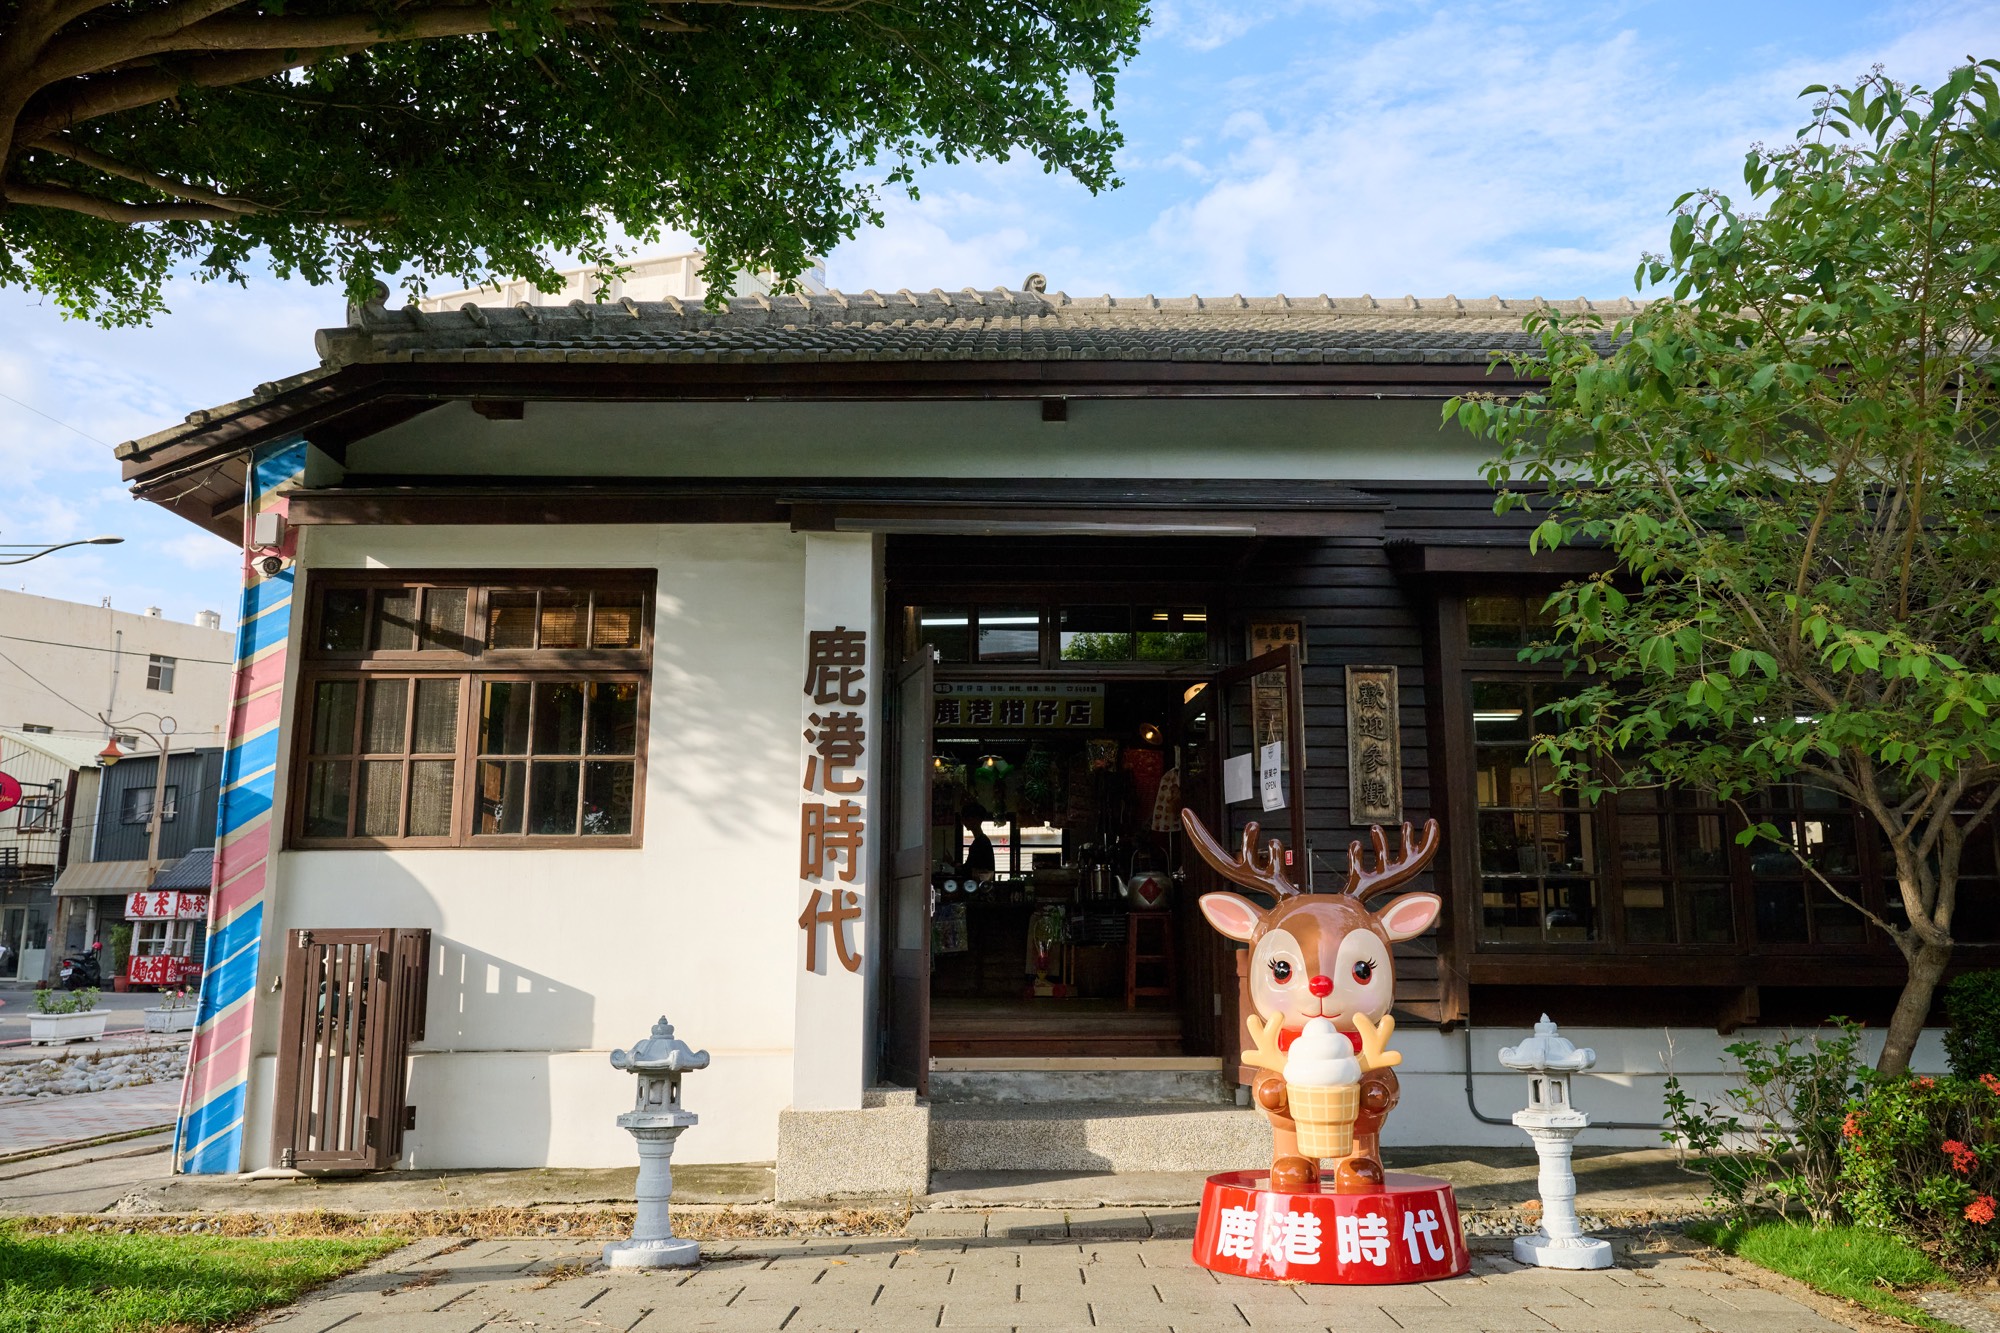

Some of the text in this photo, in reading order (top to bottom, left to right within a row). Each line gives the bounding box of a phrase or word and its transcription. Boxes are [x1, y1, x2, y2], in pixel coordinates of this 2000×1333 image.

[934, 699, 1092, 725] 鹿港柑仔店
[1357, 682, 1389, 808] 歡迎參觀
[799, 626, 866, 972] 鹿港時代
[1264, 781, 1277, 791] OPEN
[131, 891, 171, 917] 麵茶
[180, 893, 206, 913] 麵茶
[1216, 1205, 1445, 1267] 鹿港時代
